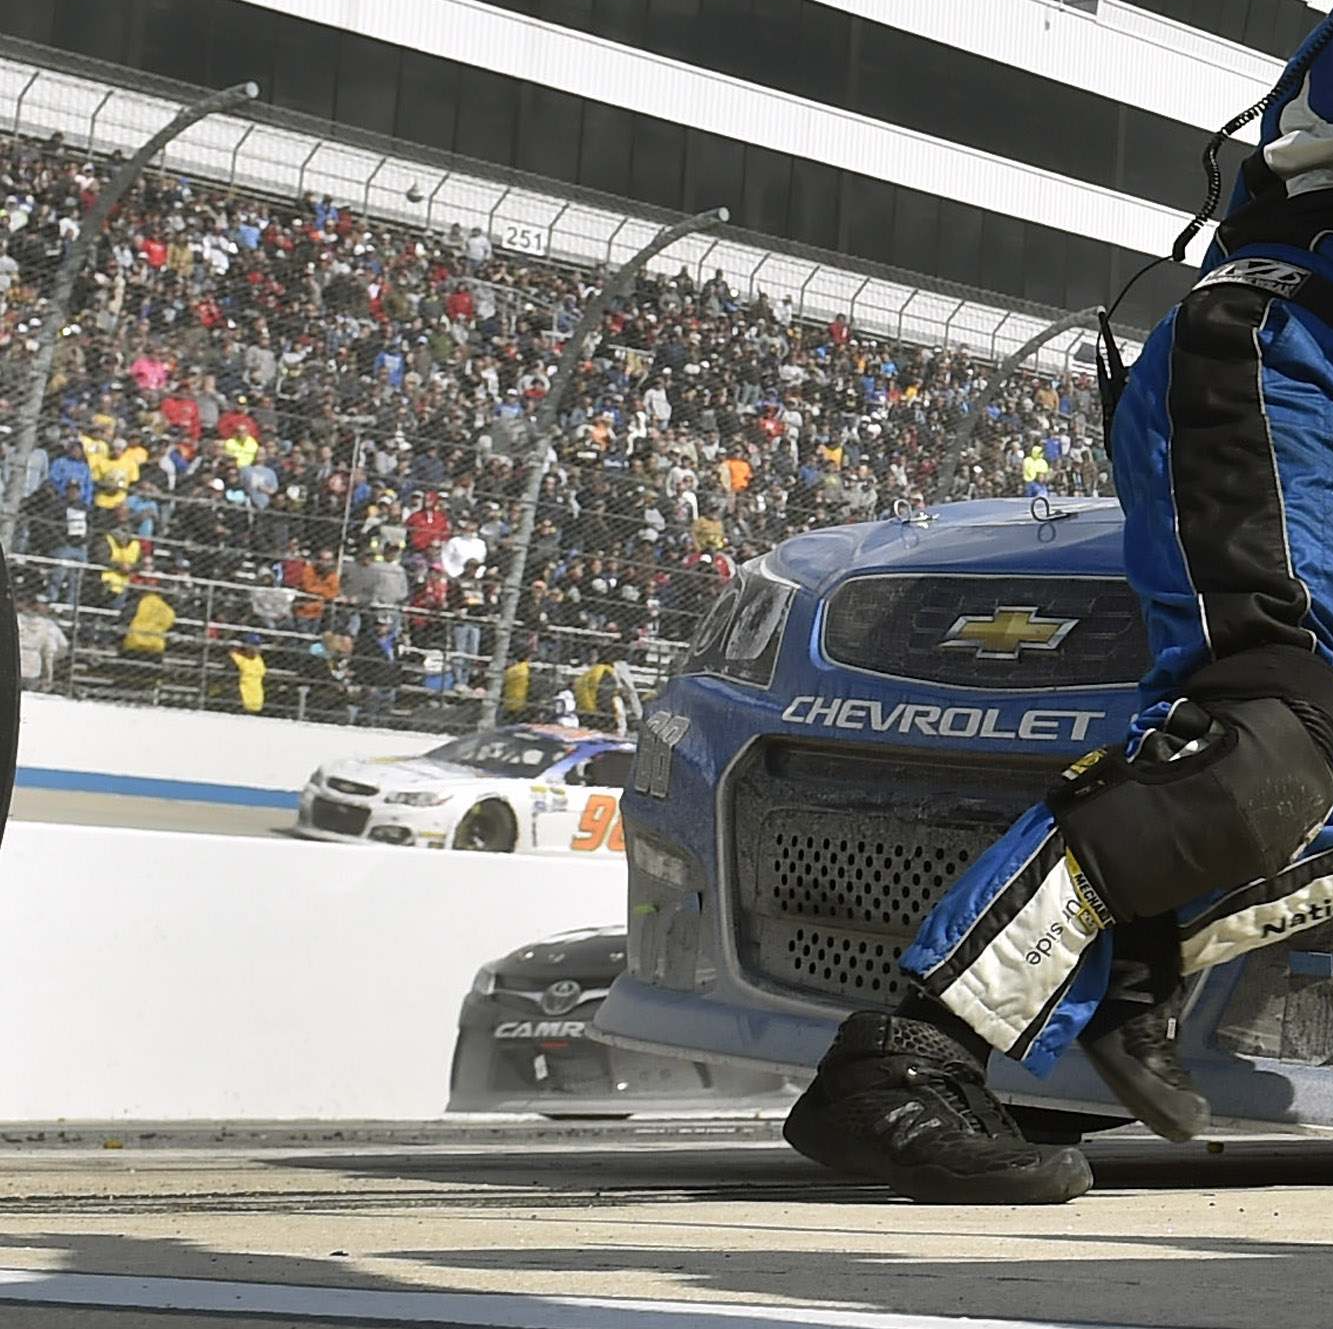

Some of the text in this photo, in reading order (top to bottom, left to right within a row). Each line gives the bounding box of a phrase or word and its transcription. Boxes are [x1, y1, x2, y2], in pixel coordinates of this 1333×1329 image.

[507, 226, 542, 251] 251
[782, 696, 1106, 741] CHEVROLET
[1026, 921, 1065, 965] side
[494, 1021, 586, 1038] CAMR
